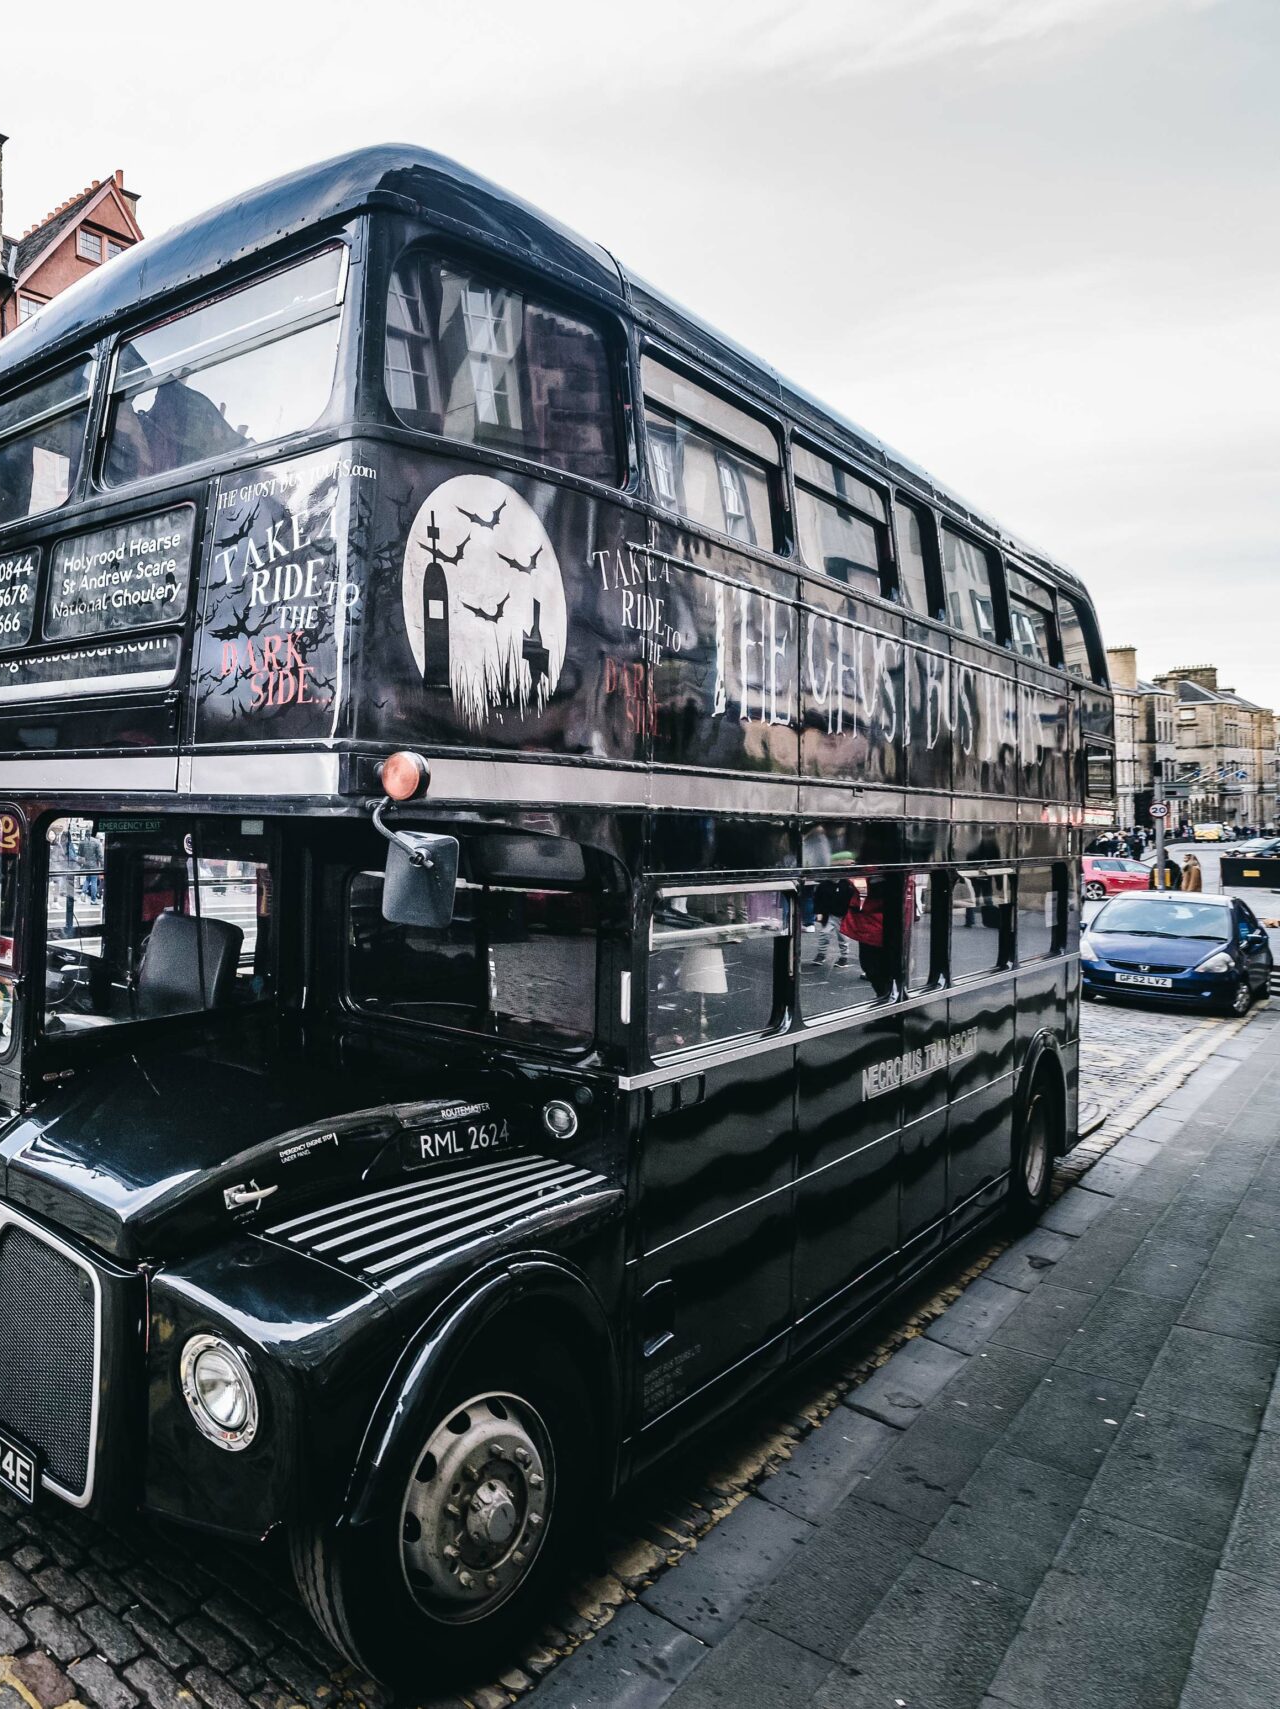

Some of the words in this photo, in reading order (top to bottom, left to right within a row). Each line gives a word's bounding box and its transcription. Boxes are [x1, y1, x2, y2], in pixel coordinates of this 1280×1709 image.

[218, 489, 237, 510] THE
[240, 479, 276, 502] GHOST
[64, 543, 125, 573] Holyrood
[130, 533, 181, 556] Hearse
[216, 510, 311, 584] TAKE
[317, 505, 338, 538] A
[62, 579, 75, 596] St
[79, 565, 132, 592] Andrew
[136, 559, 176, 580] Scare
[249, 558, 325, 607] RIDE
[324, 581, 359, 607] TO
[592, 549, 657, 591] TAKE
[52, 597, 107, 619] National
[112, 582, 183, 609] Ghoulery
[277, 605, 319, 629] THE
[621, 589, 664, 635] RIDE
[664, 623, 681, 652] TO
[221, 630, 305, 676] DARK
[640, 635, 664, 667] THE
[99, 822, 142, 830] EMERGENCY
[145, 821, 160, 830] EXIT
[1151, 806, 1165, 814] 20
[1120, 974, 1145, 984] GF52
[441, 1102, 490, 1118] ROUTEMASTER
[279, 1143, 306, 1158] EMERGENCY
[420, 1130, 464, 1159] RML
[468, 1119, 509, 1151] 2624
